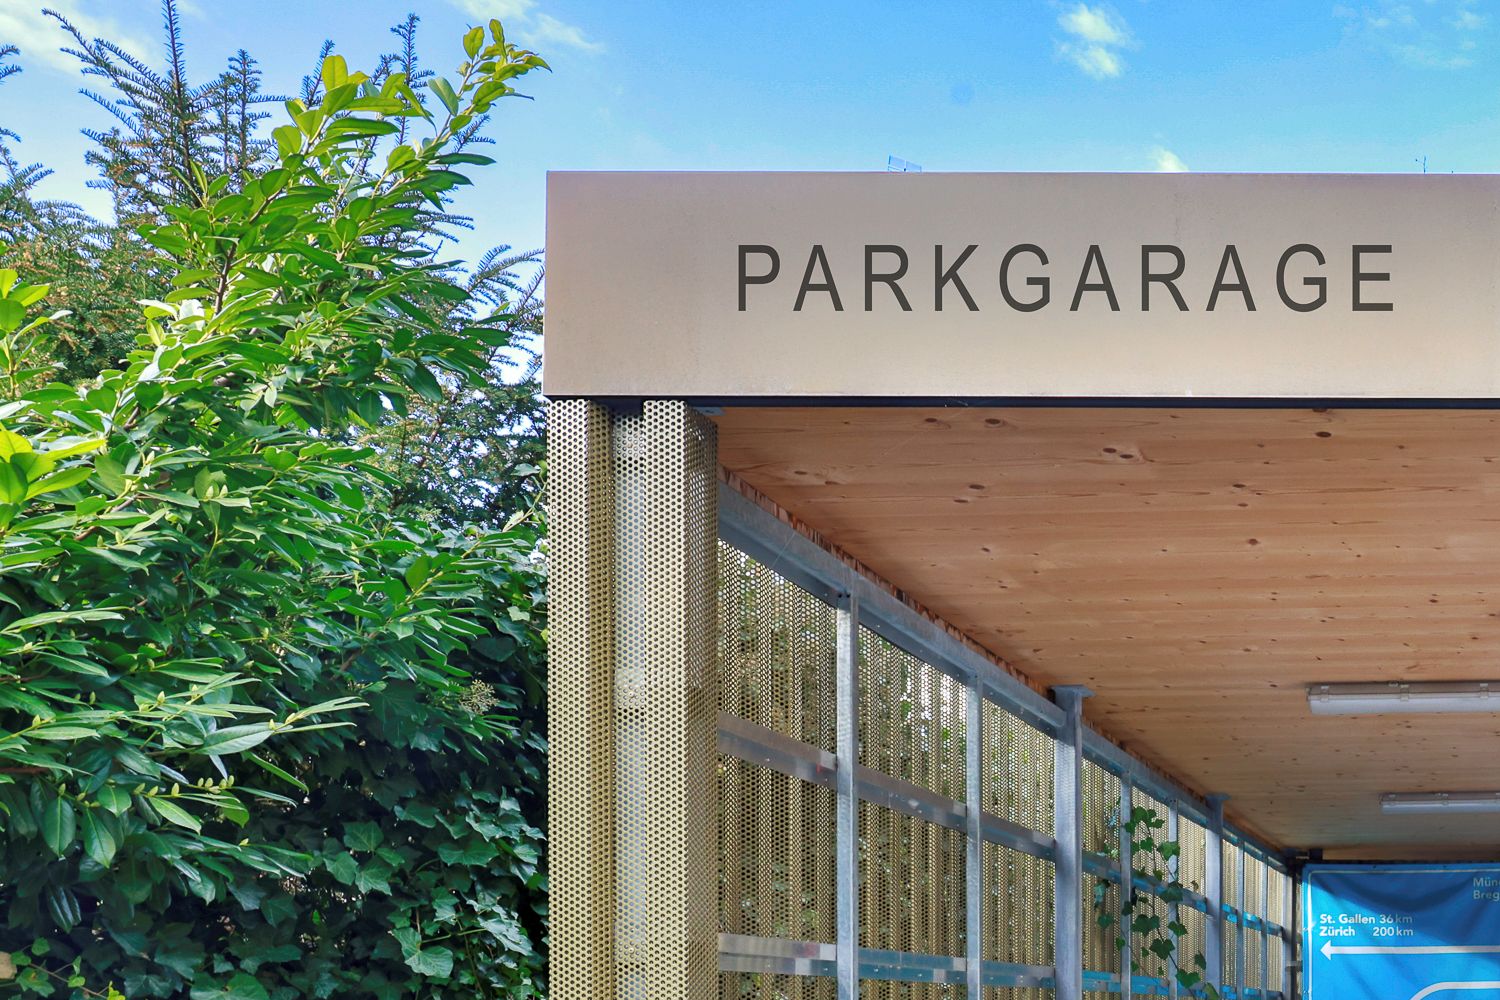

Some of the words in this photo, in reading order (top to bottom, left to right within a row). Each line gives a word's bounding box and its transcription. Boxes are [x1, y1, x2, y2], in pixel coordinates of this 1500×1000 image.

[737, 243, 1394, 313] PARKGARAGE
[1319, 913, 1336, 924] St.
[1338, 913, 1376, 924] Gallen
[1319, 925, 1356, 936] Zürich
